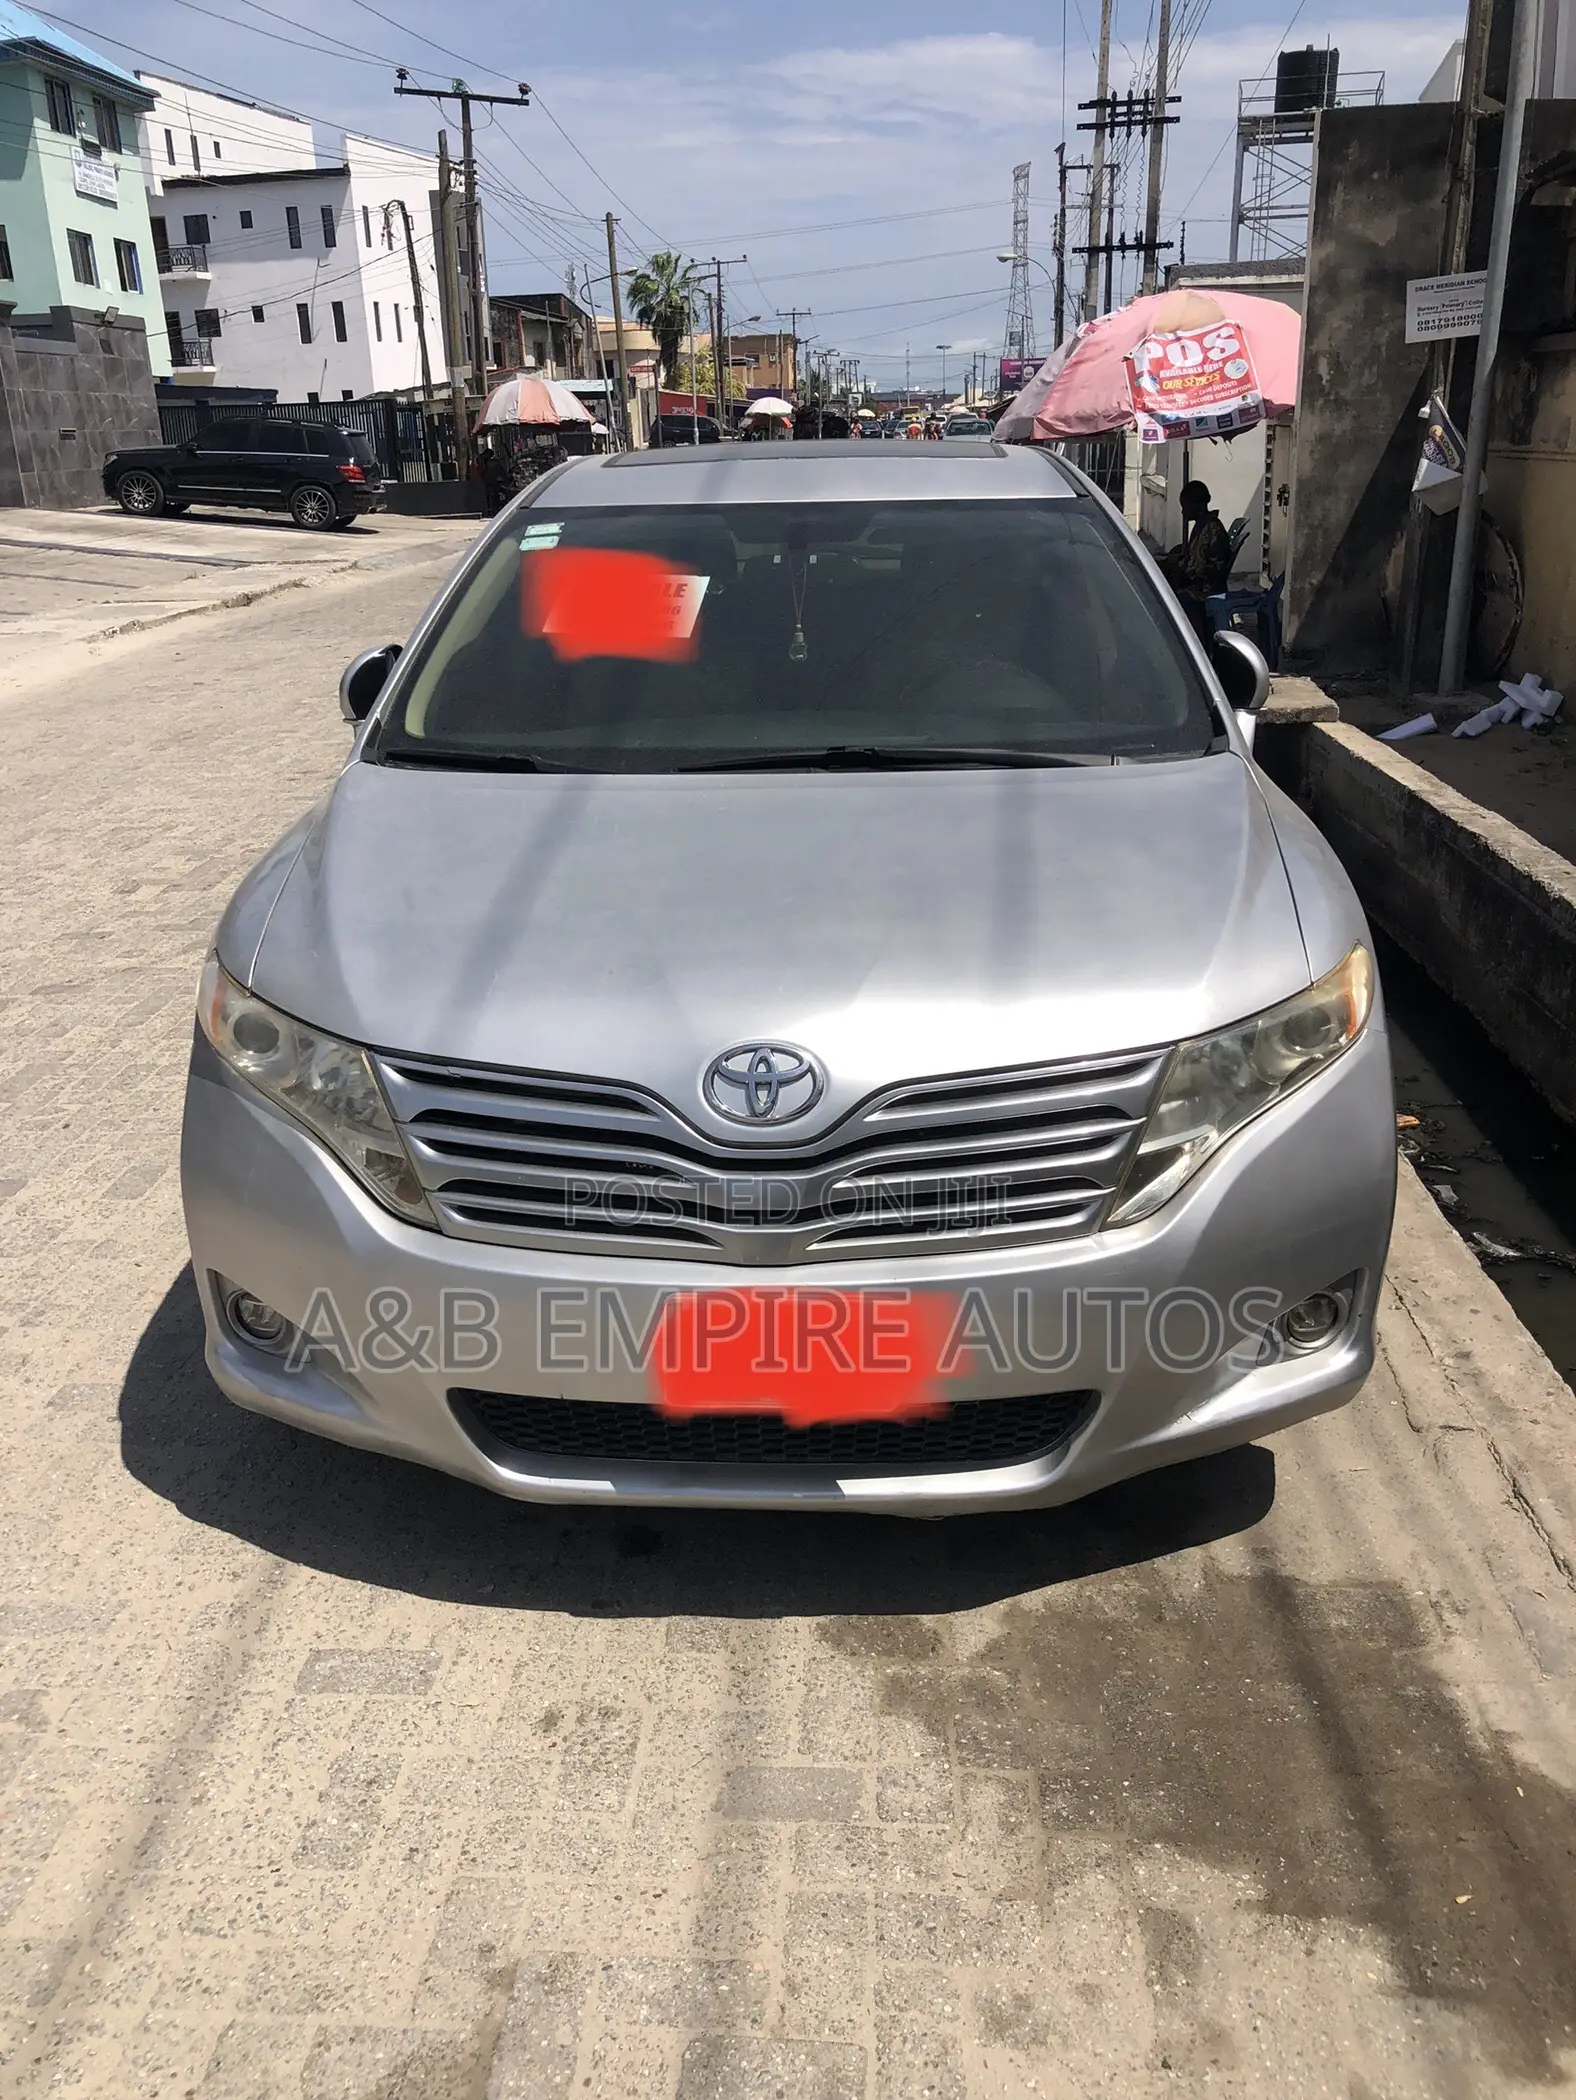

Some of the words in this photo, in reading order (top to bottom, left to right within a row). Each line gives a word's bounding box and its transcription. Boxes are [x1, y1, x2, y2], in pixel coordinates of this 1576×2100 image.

[1436, 281, 1465, 289] MERIDIAN
[1133, 326, 1240, 374] POS
[1159, 365, 1204, 379] AVAILABLE
[1203, 361, 1224, 373] HERE
[1162, 379, 1183, 390] OUR
[1212, 380, 1238, 391] DEPOSITS
